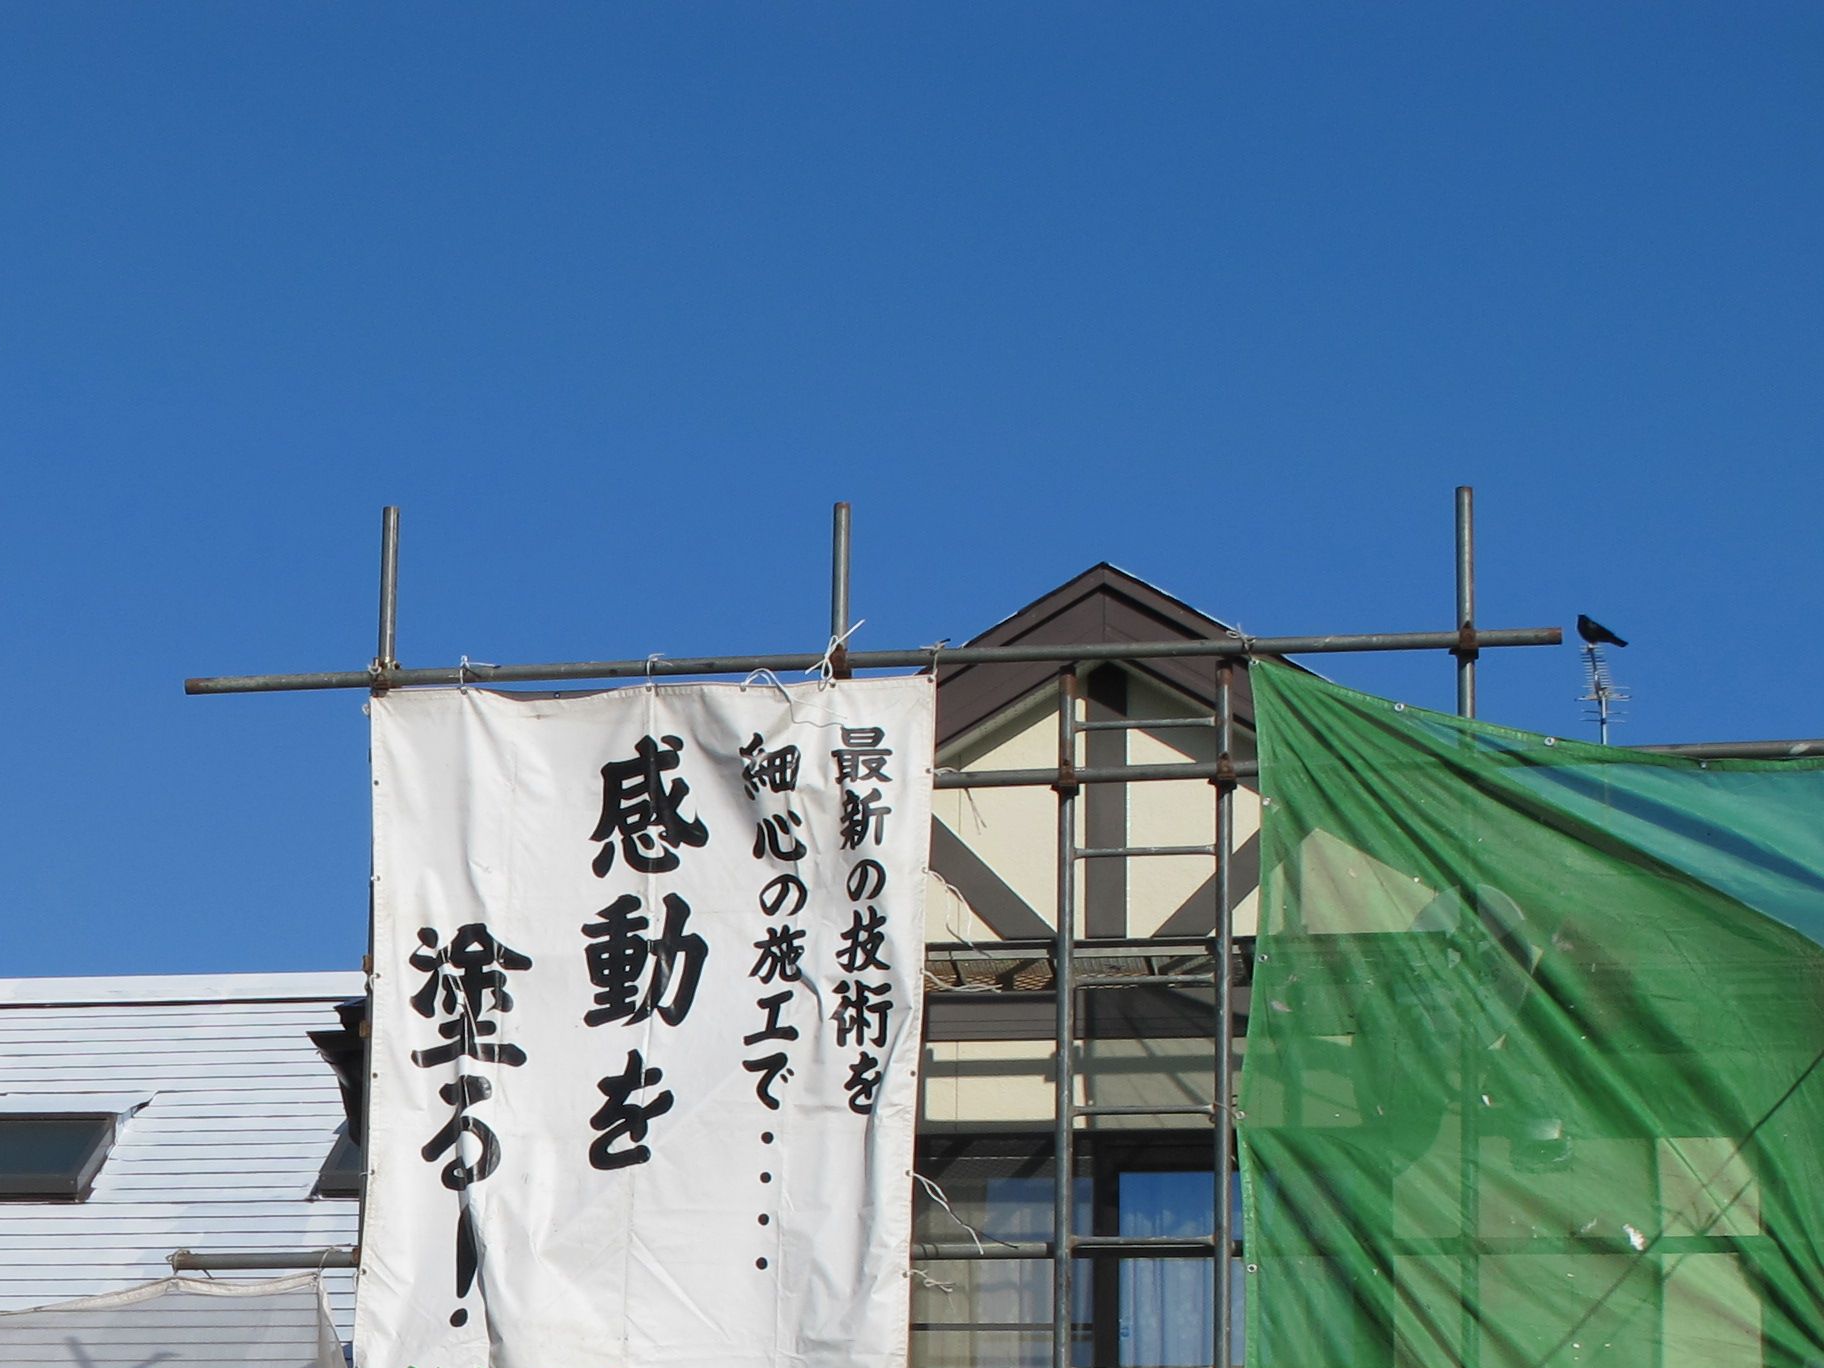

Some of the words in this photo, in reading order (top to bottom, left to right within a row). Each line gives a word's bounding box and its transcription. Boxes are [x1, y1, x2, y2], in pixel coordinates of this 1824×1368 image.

[580, 733, 710, 1172] 感動を
[830, 725, 894, 1116] 最新の技術を
[408, 921, 534, 1329] 塗る!
